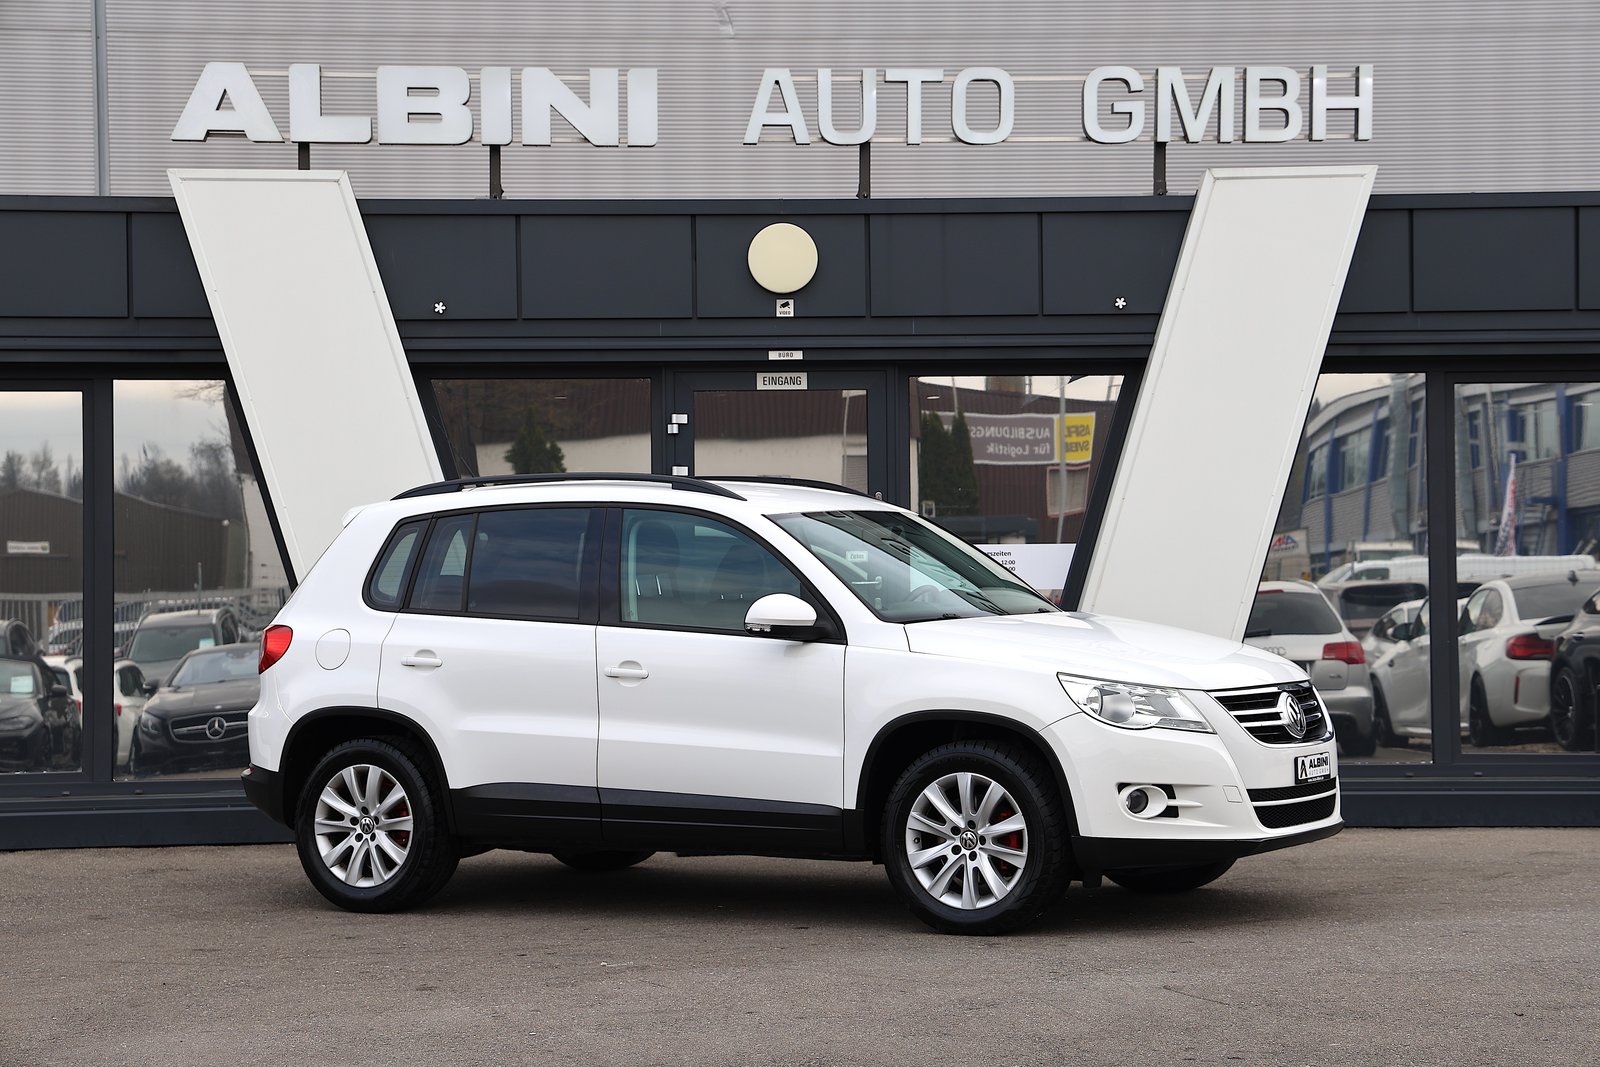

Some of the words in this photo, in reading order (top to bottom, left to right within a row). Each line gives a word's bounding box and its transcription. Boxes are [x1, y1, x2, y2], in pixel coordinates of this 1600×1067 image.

[170, 61, 658, 147] ALBINI
[742, 66, 1015, 146] AUTO
[1082, 63, 1374, 145] GMBH
[762, 376, 802, 386] EINGANG
[1309, 756, 1329, 769] ALBINI
